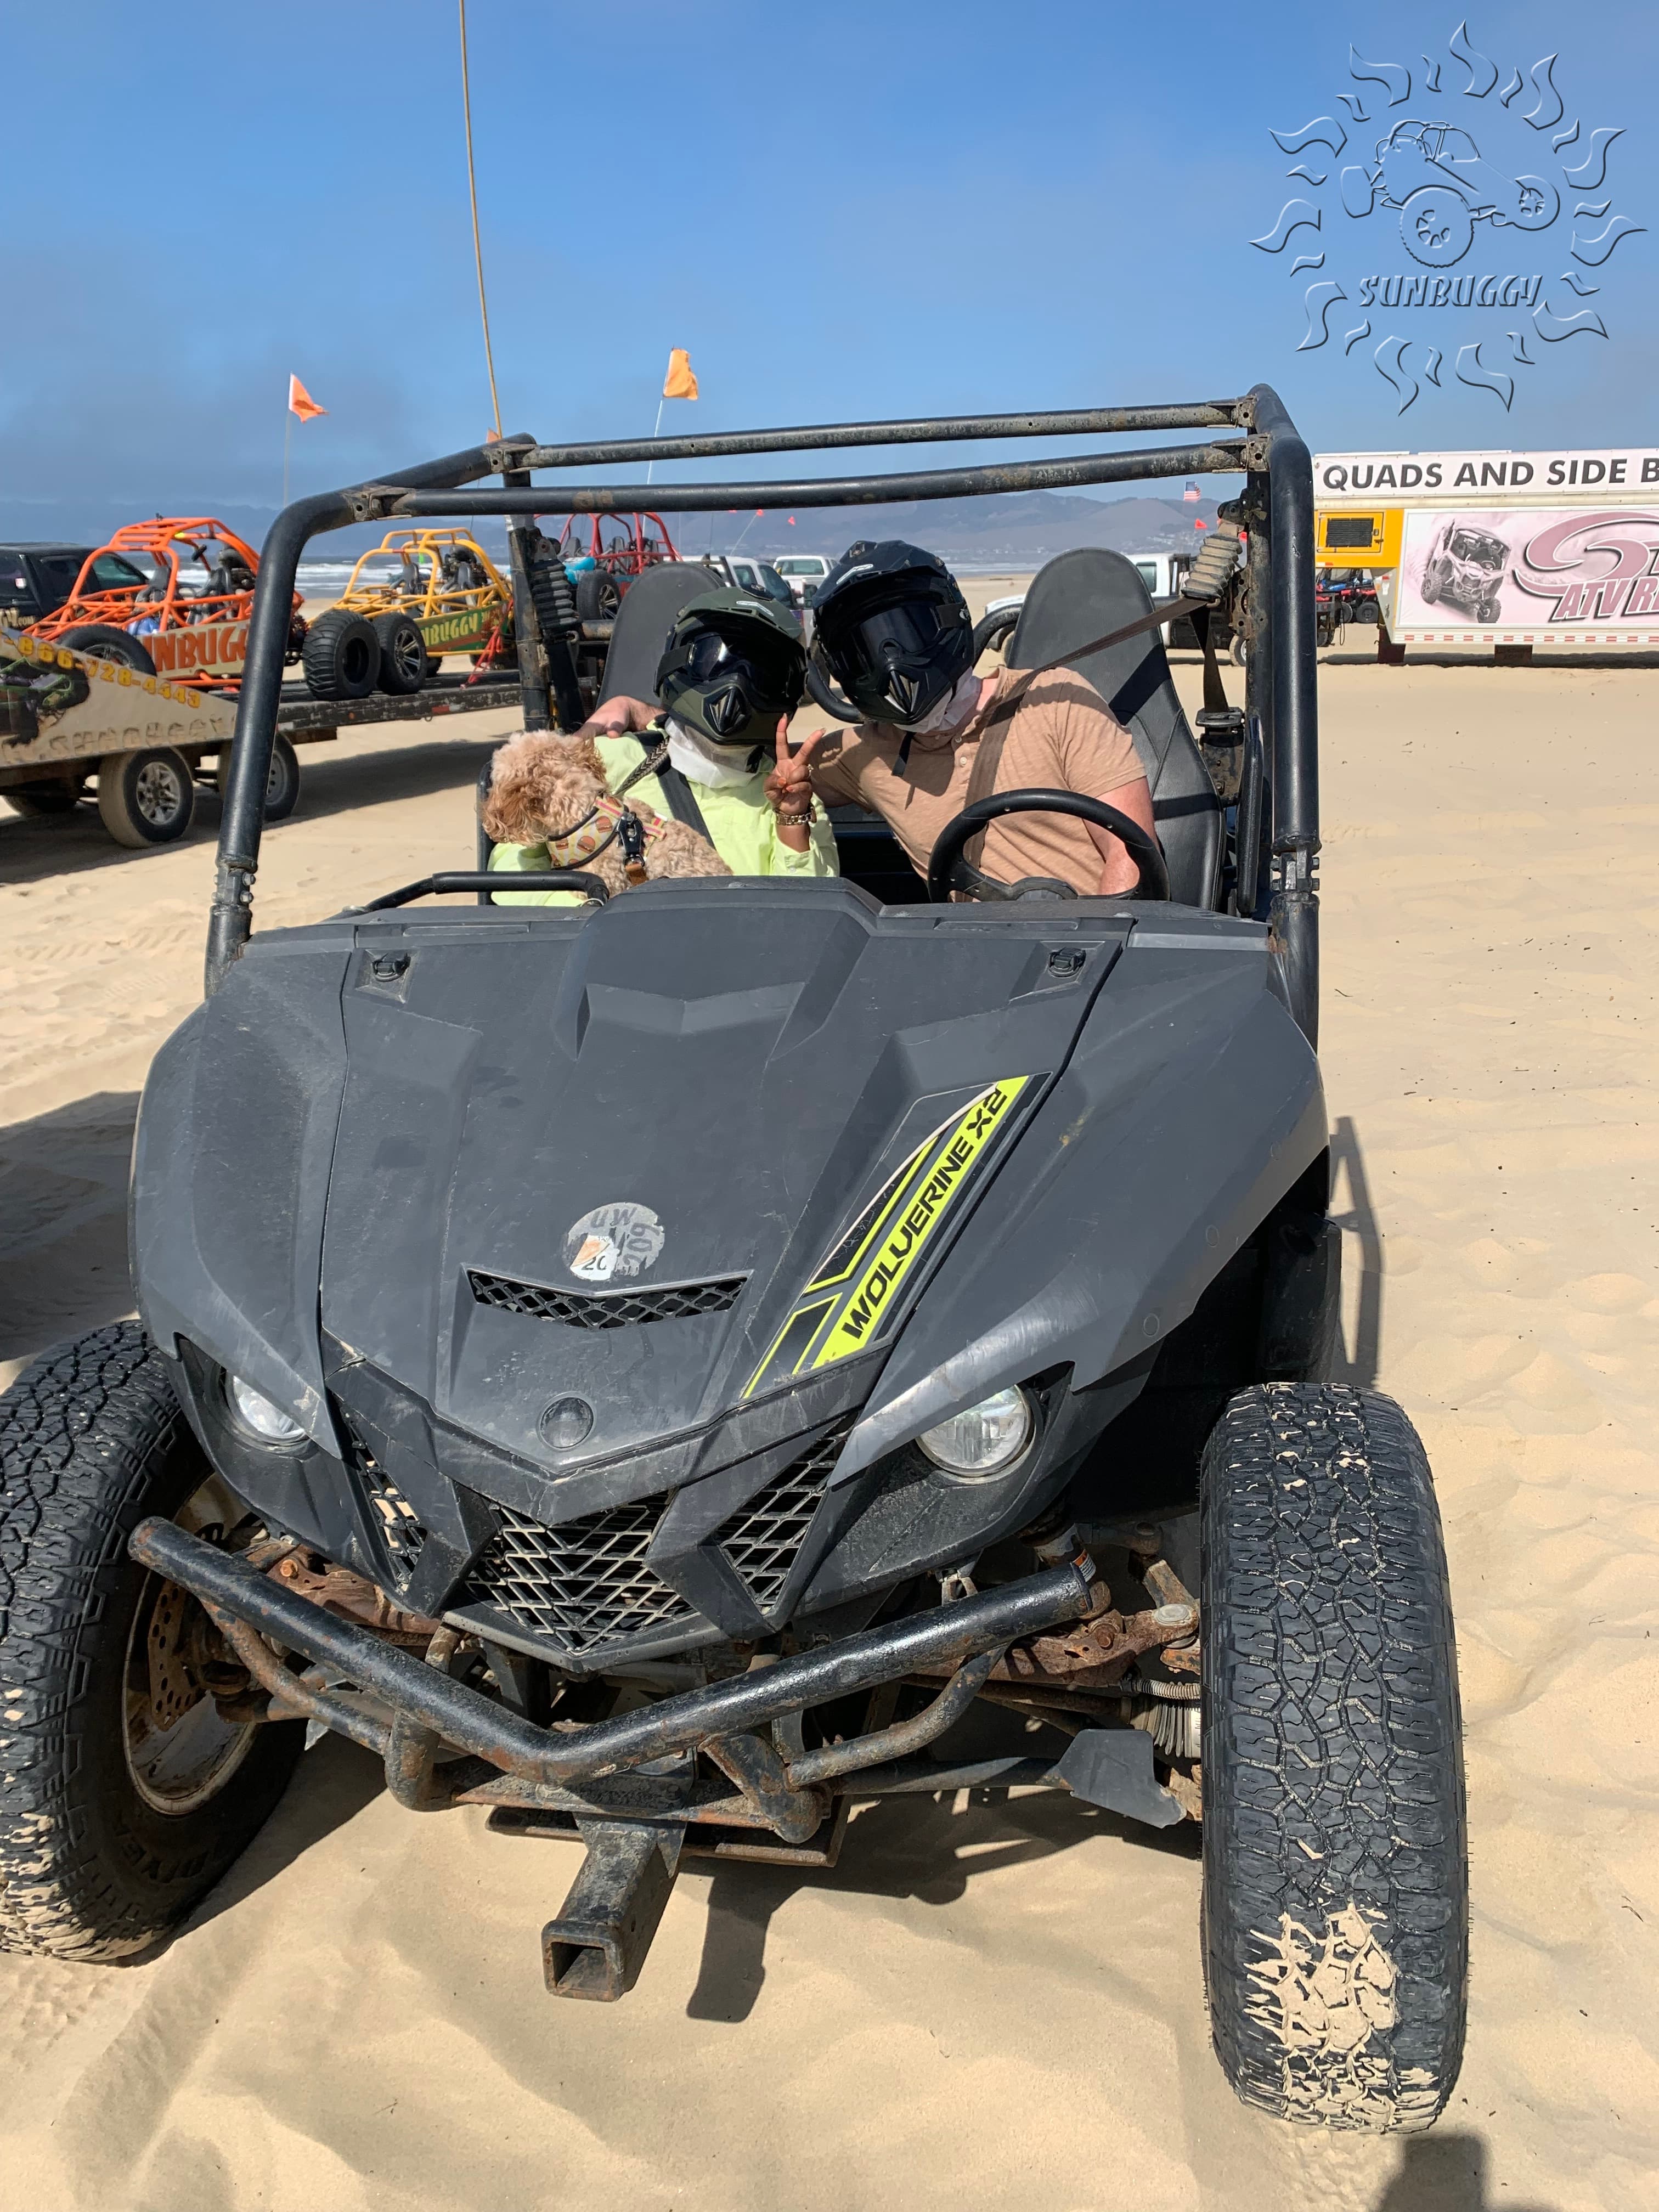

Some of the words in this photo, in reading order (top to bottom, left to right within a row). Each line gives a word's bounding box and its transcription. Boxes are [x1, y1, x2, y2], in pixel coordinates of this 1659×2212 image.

[1323, 462, 1443, 491] QUADS
[1453, 461, 1534, 487] AND
[1546, 459, 1627, 486] SIDE
[1550, 577, 1635, 622] ATV
[841, 1139, 974, 1340] WOLVERINE
[966, 1088, 1008, 1140] X2
